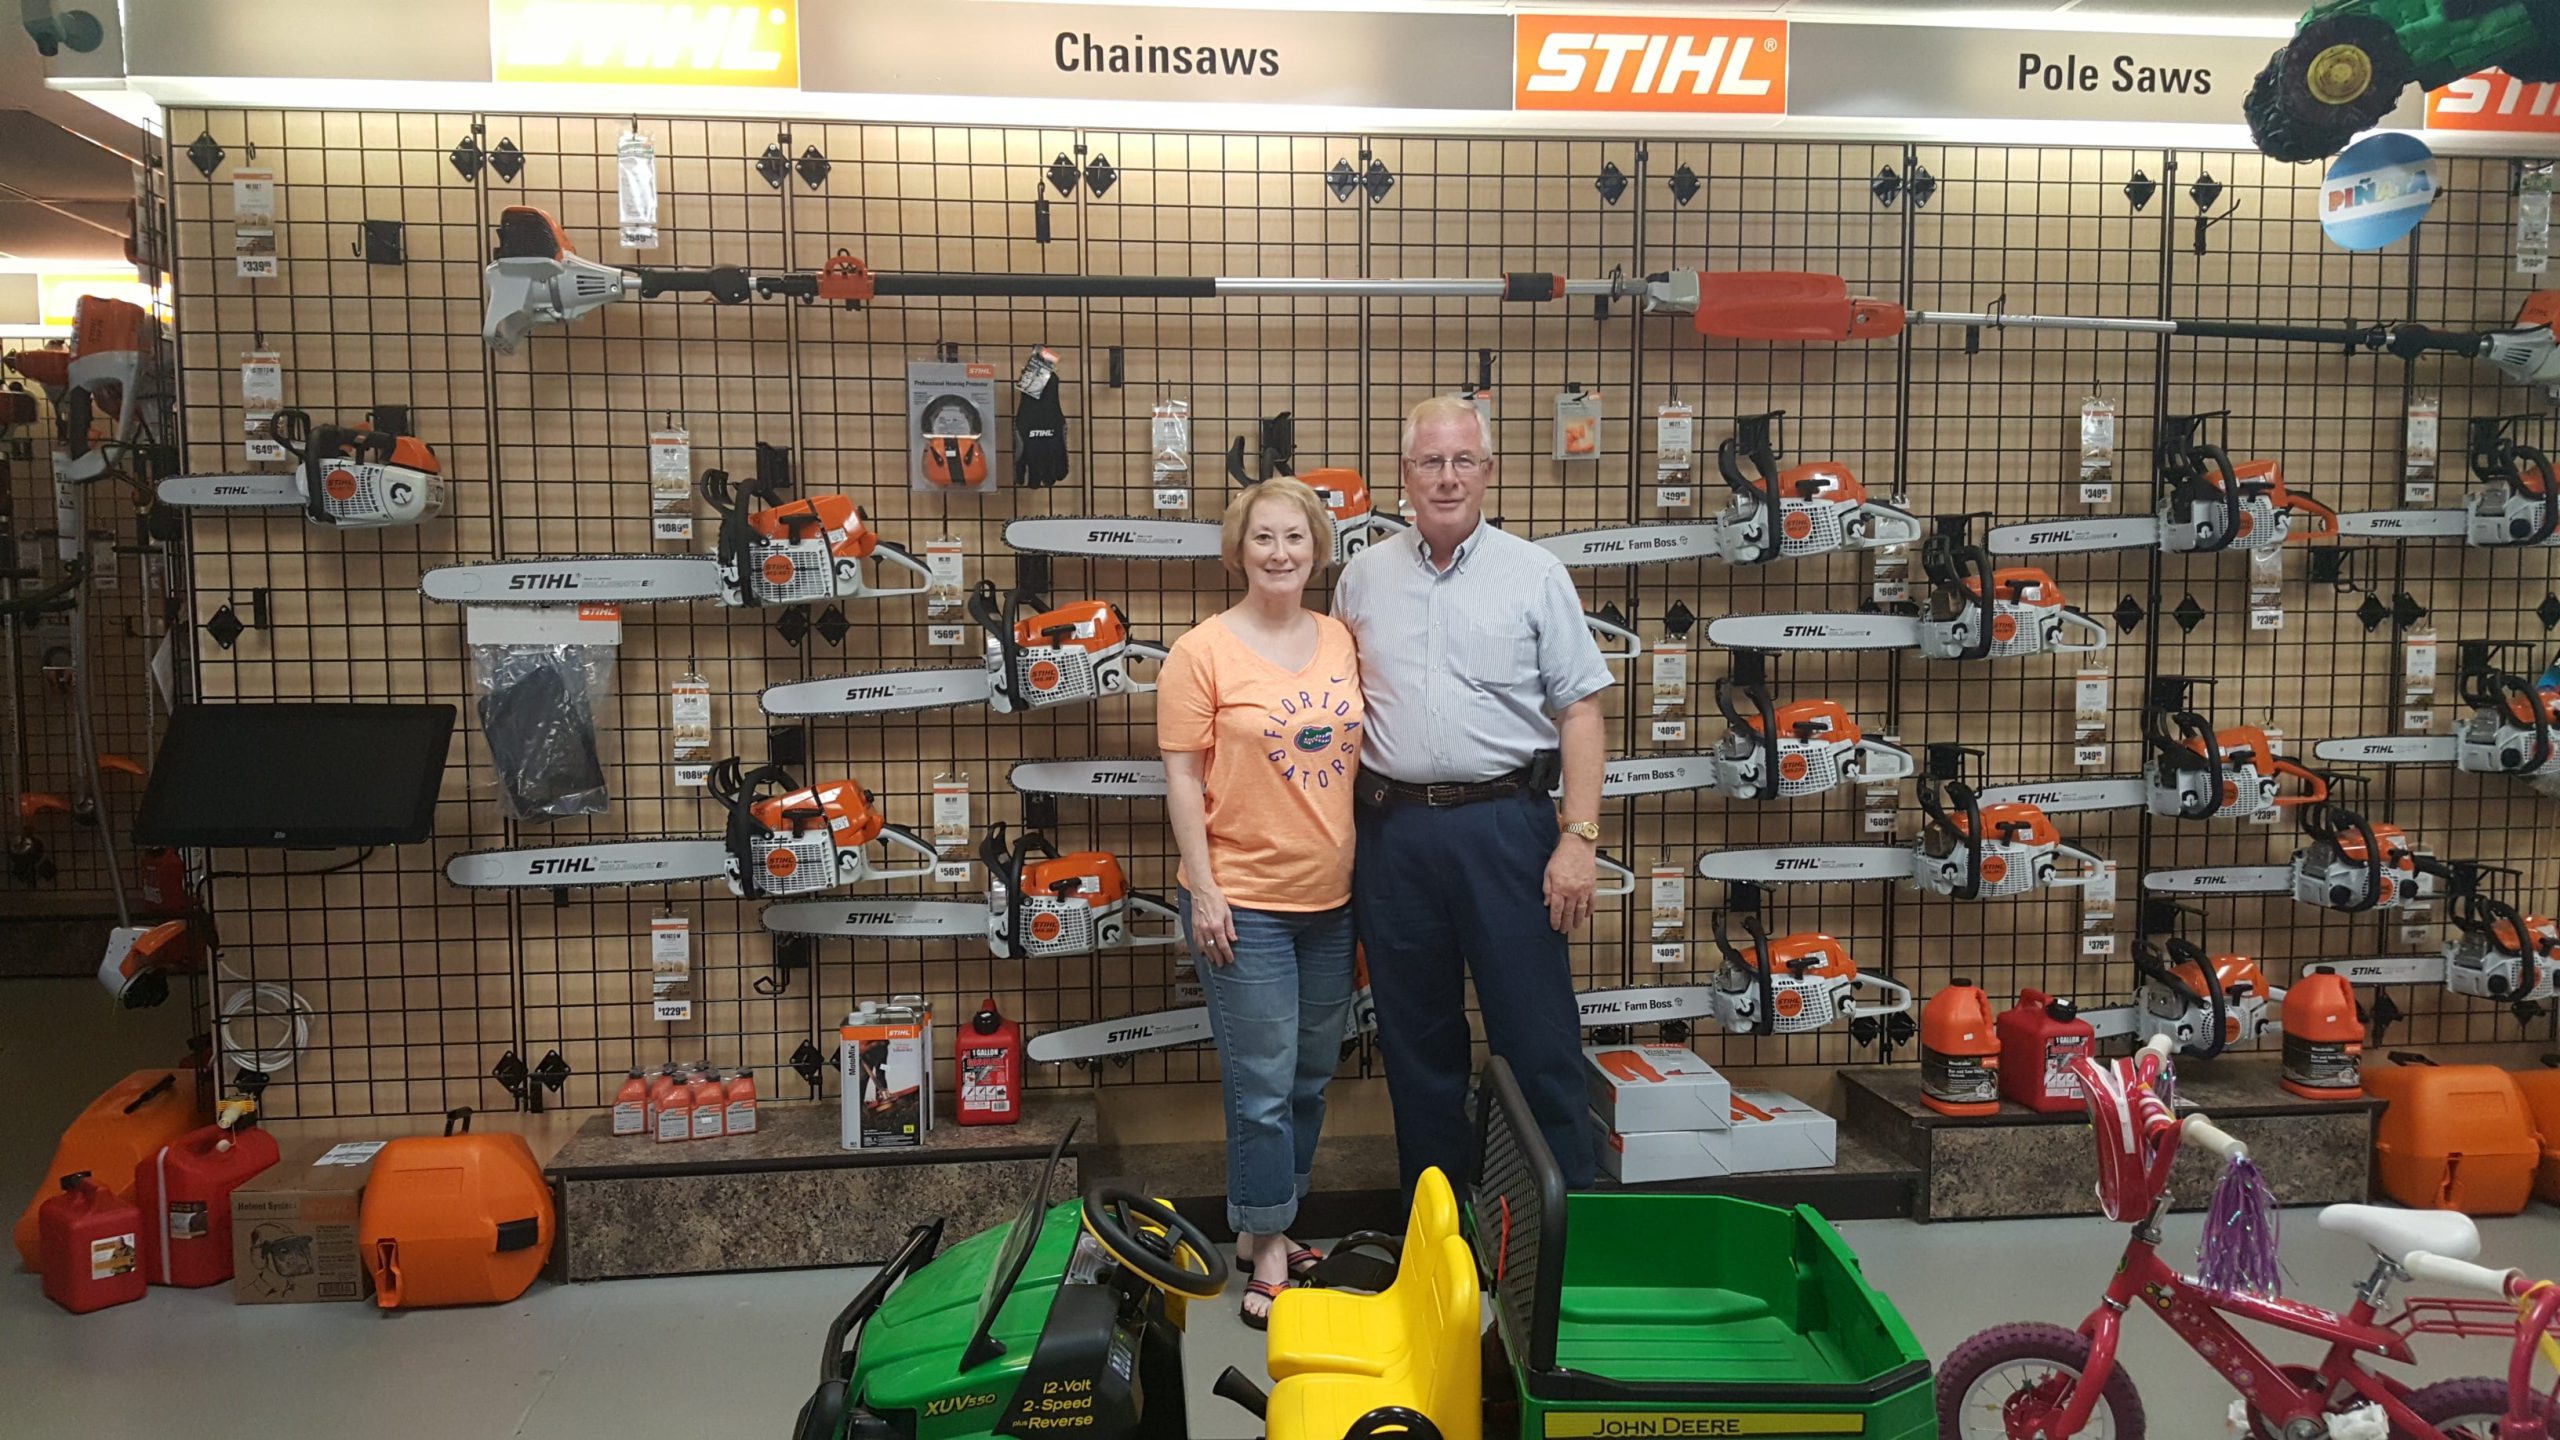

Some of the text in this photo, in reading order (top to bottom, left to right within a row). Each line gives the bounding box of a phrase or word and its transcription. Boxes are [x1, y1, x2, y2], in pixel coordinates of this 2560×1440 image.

[1055, 31, 1279, 77] Chainsaws
[2018, 53, 2211, 95] Pole Saws
[2328, 170, 2430, 212] PIÑAA
[1029, 430, 1053, 438] STIHL
[213, 486, 249, 496] STIHL
[2370, 519, 2402, 528] STIHL
[1087, 531, 1134, 543] STIHL
[2029, 531, 2073, 544] STIHL
[1583, 538, 1677, 553] STIHL Farm Boss
[509, 574, 579, 590] STIHL
[581, 607, 616, 616] STIHL
[1783, 626, 1826, 637] STIHL
[846, 685, 894, 701] STIHL
[1264, 691, 1360, 739] FLORIDA
[2363, 745, 2394, 754] STIHL
[1269, 742, 1355, 790] GATORS
[1091, 773, 1138, 784] STIHL
[1627, 772, 1650, 782] Farm
[1652, 770, 1675, 780] Boss
[2017, 792, 2060, 804] STIHL
[529, 857, 596, 875] STIHL
[1775, 858, 1818, 870] STIHL
[2194, 876, 2227, 884] STIHL
[846, 913, 894, 924] STIHL
[2351, 966, 2383, 975] STIHL
[1580, 1000, 1673, 1014] STIHL Farm Boss
[888, 1029, 911, 1037] STIHL
[1107, 1026, 1152, 1043] STIHL
[977, 1048, 999, 1056] GALLON
[848, 1044, 856, 1076] MotoMix
[238, 1202, 266, 1211] Helmet
[1043, 1379, 1092, 1395] 12-Volt
[924, 1393, 996, 1418] XUV550
[1022, 1396, 1093, 1413] 2-Speed
[1012, 1415, 1094, 1430] plus Reverse
[1592, 1417, 1741, 1435] JOHN DEERE
